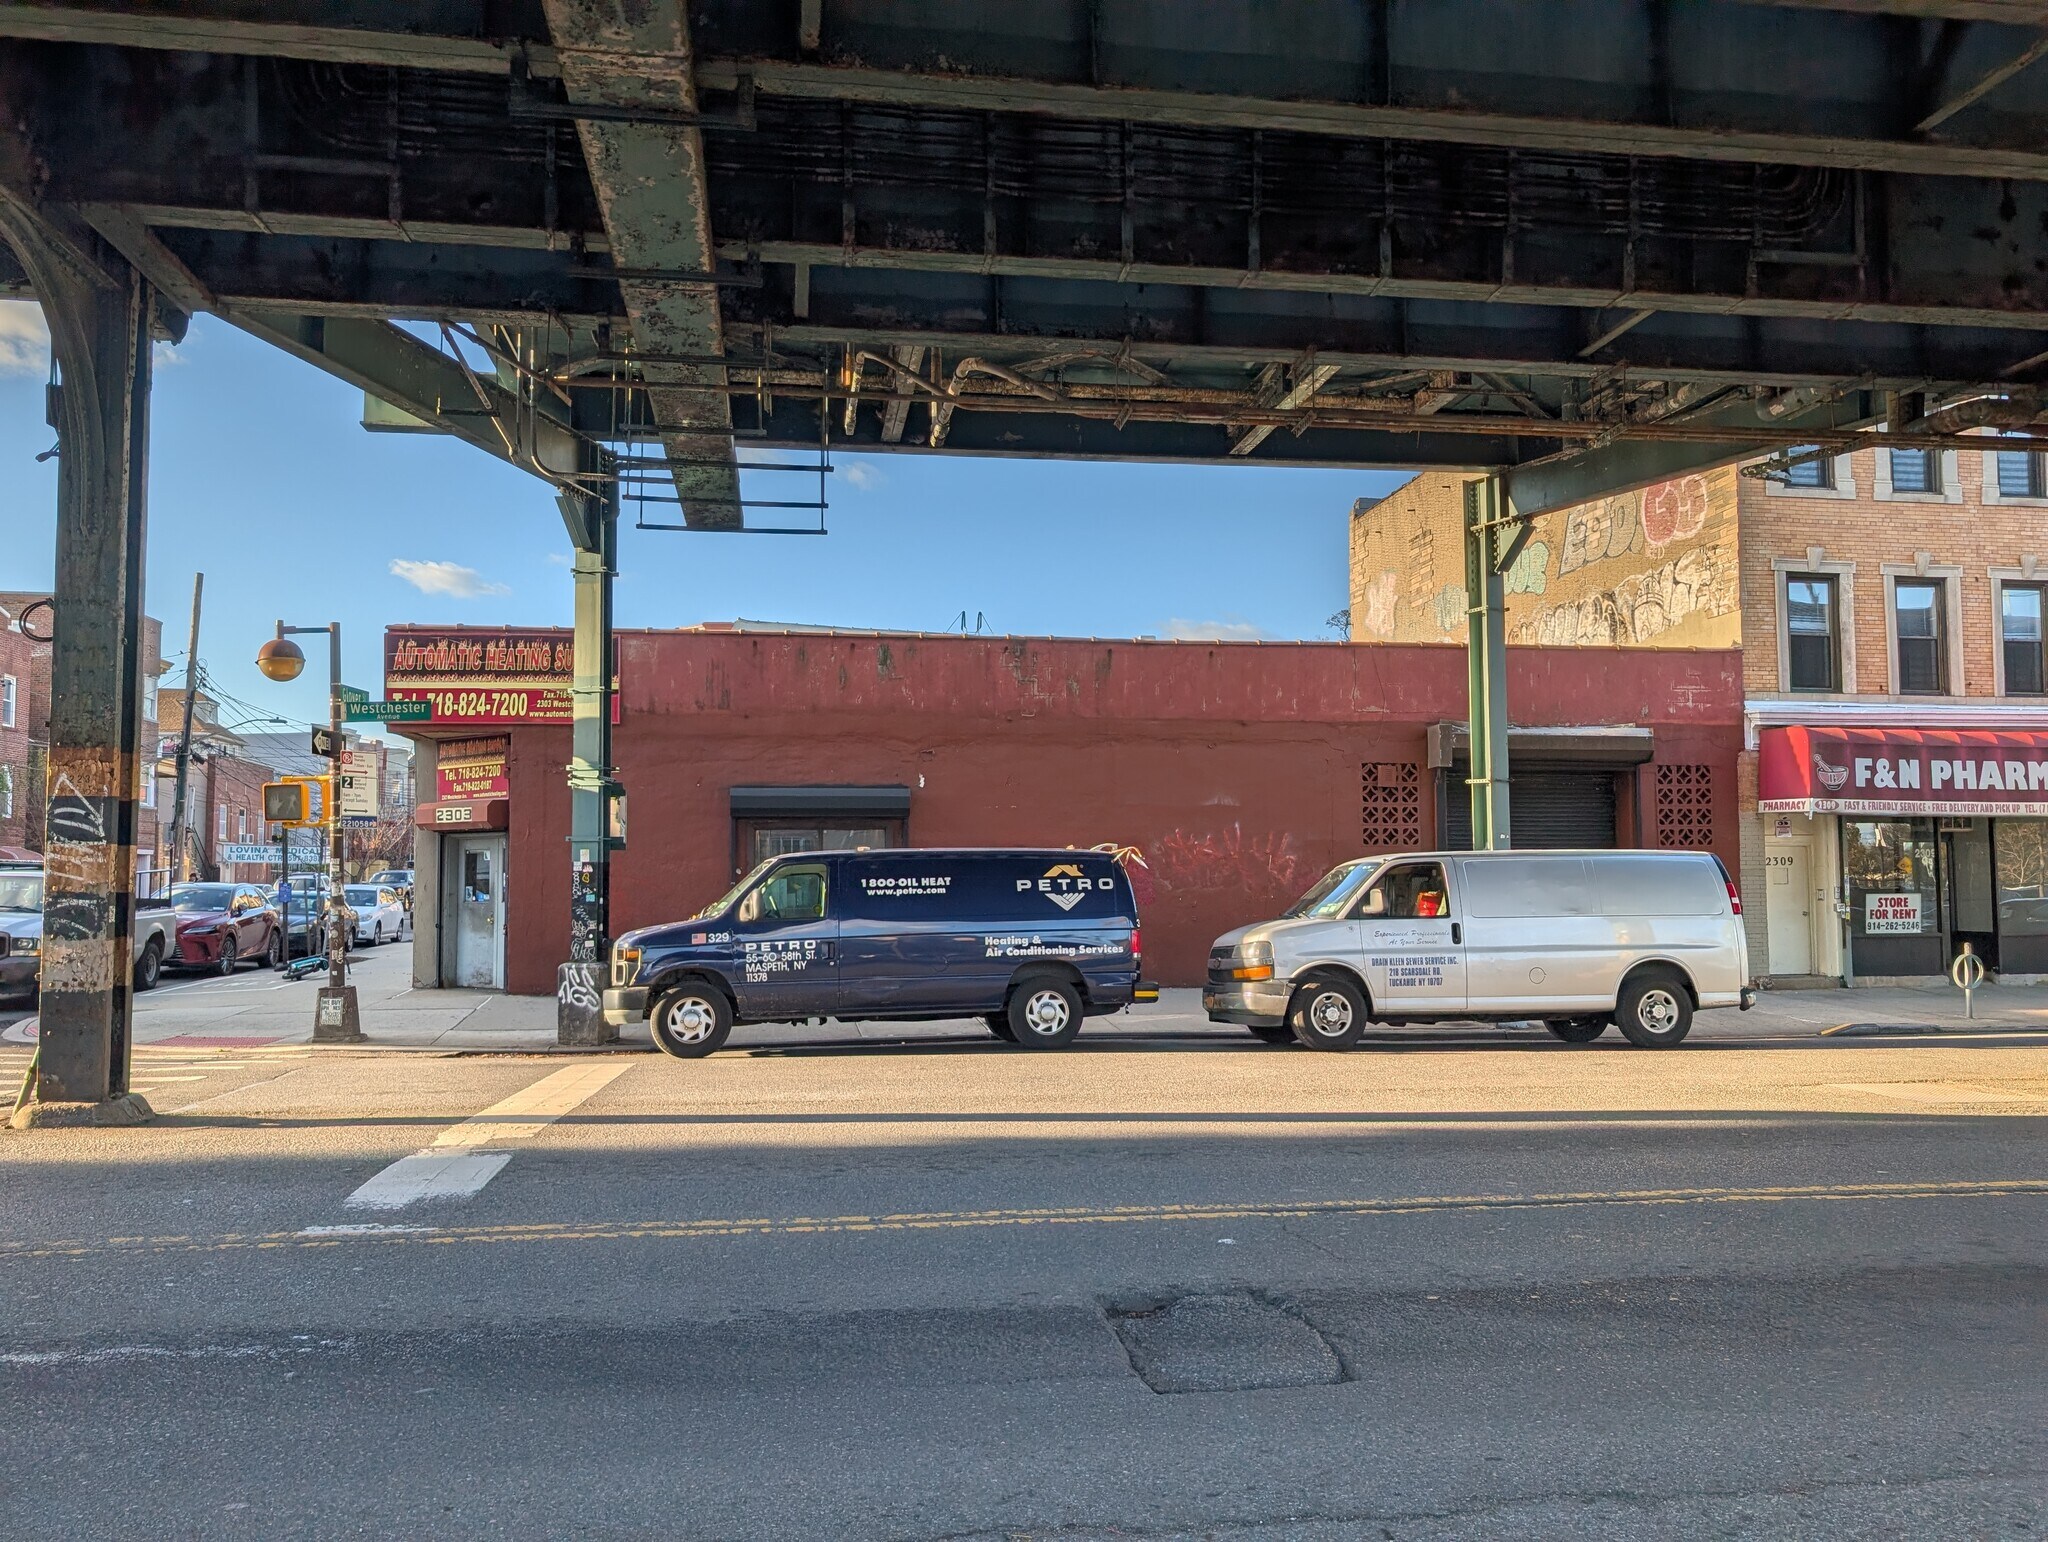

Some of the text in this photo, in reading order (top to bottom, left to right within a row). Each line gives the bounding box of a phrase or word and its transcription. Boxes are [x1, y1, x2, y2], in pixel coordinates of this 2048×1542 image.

[394, 643, 483, 670] AUTOMATIC
[486, 643, 551, 671] HEATING
[350, 702, 426, 714] Westchester
[537, 700, 552, 708] 2303
[445, 765, 501, 781] Tel. 718-824-7200
[1855, 758, 2048, 790] F&N PHARM
[344, 777, 351, 788] 2
[1763, 801, 1807, 812] PHARMACY
[1844, 801, 1860, 811] FAST
[1861, 802, 1867, 810] &
[1868, 802, 1898, 811] FRIENDLY
[1899, 803, 1927, 812] SERVICE
[1932, 803, 1948, 812] FREE
[1949, 803, 1980, 812] DELIVERY
[1980, 804, 1994, 813] AND
[1995, 804, 2011, 813] PICK
[2011, 804, 2021, 813] UP
[2025, 804, 2038, 813] TEL.
[437, 808, 472, 821] 2303
[342, 819, 369, 828] 221058
[229, 846, 269, 854] LOVINA
[1766, 856, 1794, 866] 2309
[921, 877, 951, 886] HEAT
[1016, 877, 1114, 892] PETRO
[867, 887, 946, 897] www.petro.com
[1877, 897, 1909, 908] STORE
[1869, 909, 1918, 919] FOR RENT
[1867, 921, 1920, 931] 914-262-5246
[708, 932, 729, 942] 329
[1374, 929, 1450, 938] Experienced Professionals
[745, 940, 817, 952] PETRO
[985, 935, 1042, 946] Heating &
[985, 944, 1124, 957] Air Conditioning Services
[746, 950, 818, 963] 55-60 58th ST.
[1371, 956, 1459, 967] DRAIN KLEEN SEWER SERVICE INC.
[746, 961, 808, 973] MASPETH, NY
[1401, 967, 1431, 976] SCARSDALE
[1432, 967, 1443, 976] RD.
[747, 973, 768, 983] 11378
[1389, 978, 1417, 987] TUCKAHOE
[1418, 978, 1426, 987] NY
